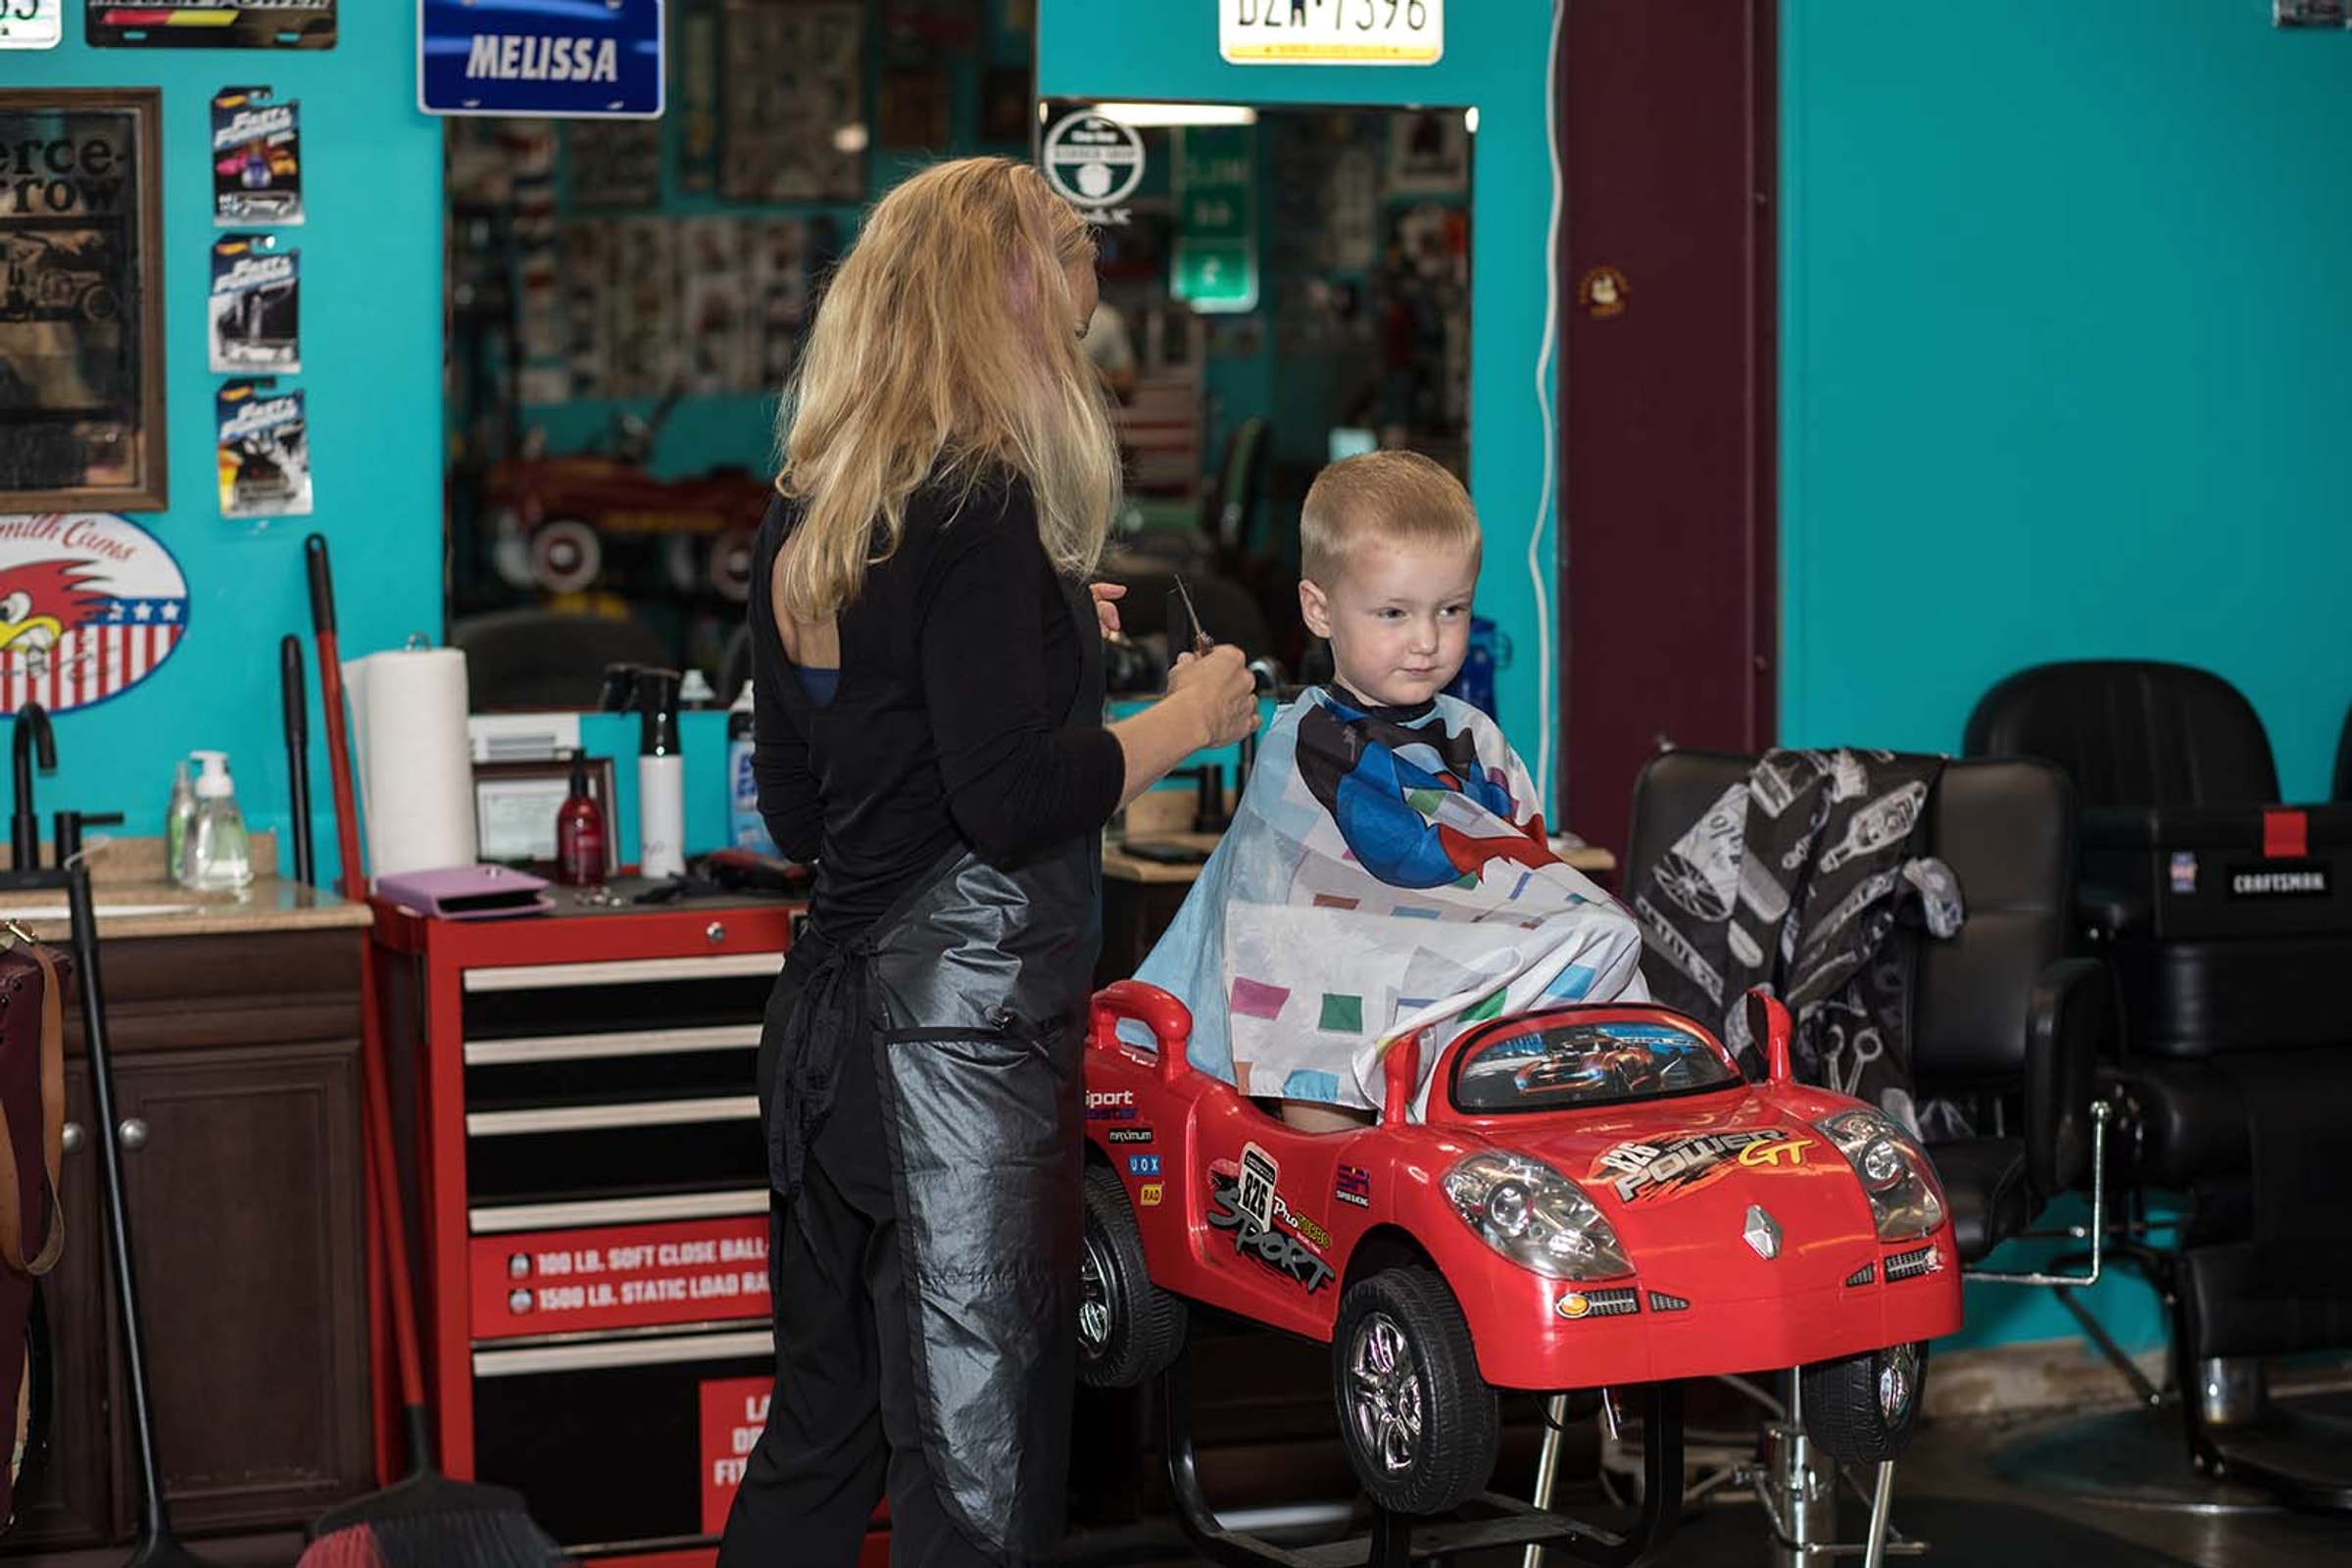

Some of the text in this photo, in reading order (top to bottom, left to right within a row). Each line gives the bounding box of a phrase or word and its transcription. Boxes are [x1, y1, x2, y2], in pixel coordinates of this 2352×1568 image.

[466, 35, 618, 82] MELISSA
[2233, 872, 2325, 893] CRAFTSMAN
[1599, 1142, 1661, 1175] 826
[1615, 1129, 1813, 1202] POWER GT
[1242, 1171, 1269, 1221] 826
[538, 1251, 571, 1275] 100
[574, 1248, 605, 1273] LB.
[608, 1244, 655, 1271] SOFT
[659, 1240, 716, 1266] CLOSE
[538, 1286, 585, 1311] 1500
[588, 1283, 617, 1307] LB.
[621, 1278, 685, 1304] STATIC
[689, 1274, 738, 1299] LOAD
